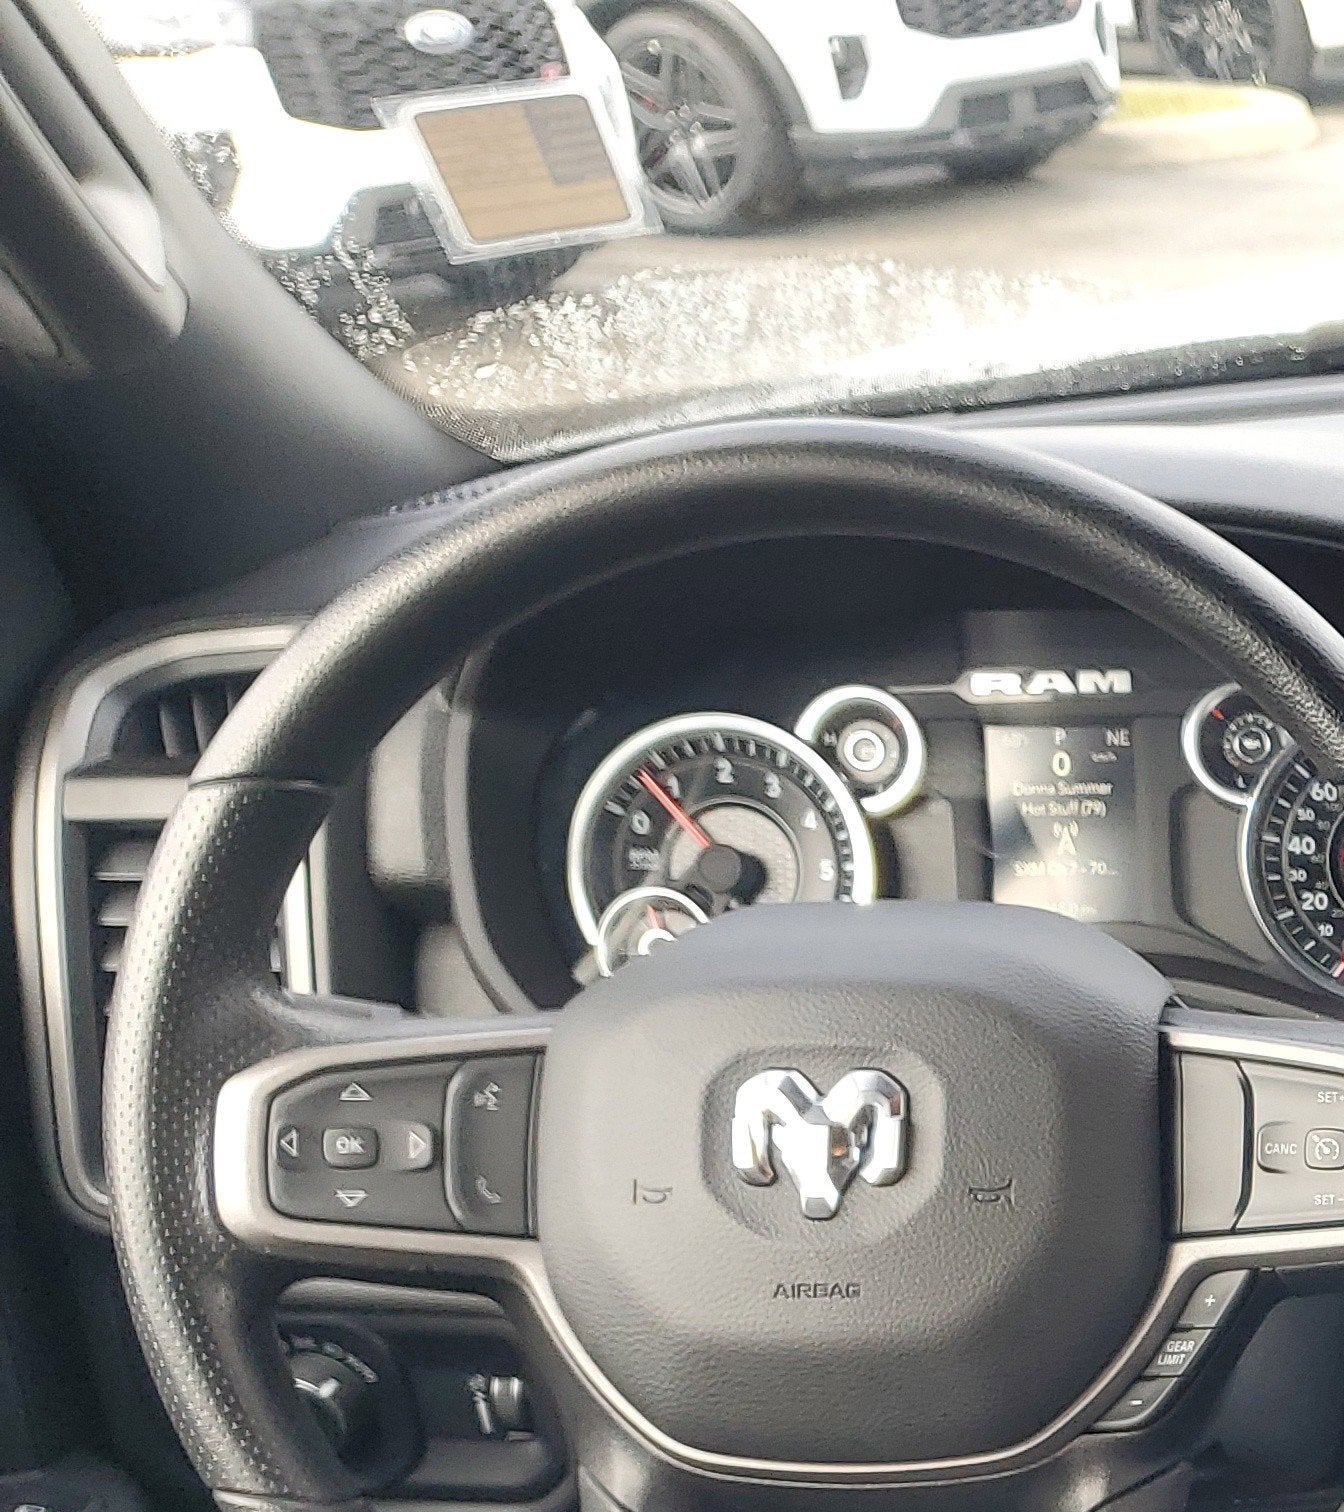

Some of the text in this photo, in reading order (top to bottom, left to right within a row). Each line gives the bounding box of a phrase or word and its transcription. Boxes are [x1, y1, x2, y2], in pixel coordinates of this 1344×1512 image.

[970, 669, 1132, 695] RAM
[714, 757, 734, 784] 2
[1052, 750, 1071, 776] 0
[764, 771, 781, 799] 3
[1310, 781, 1338, 802] 60
[630, 810, 650, 835] 0
[1288, 835, 1316, 855] 40
[1301, 891, 1329, 911] 20
[1318, 923, 1334, 937] 10
[336, 1135, 364, 1154] OK
[1265, 1143, 1297, 1155] CANC
[772, 1281, 861, 1299] AIRBAG
[1166, 1340, 1195, 1351] GEAR
[1157, 1354, 1186, 1366] LIMIT
